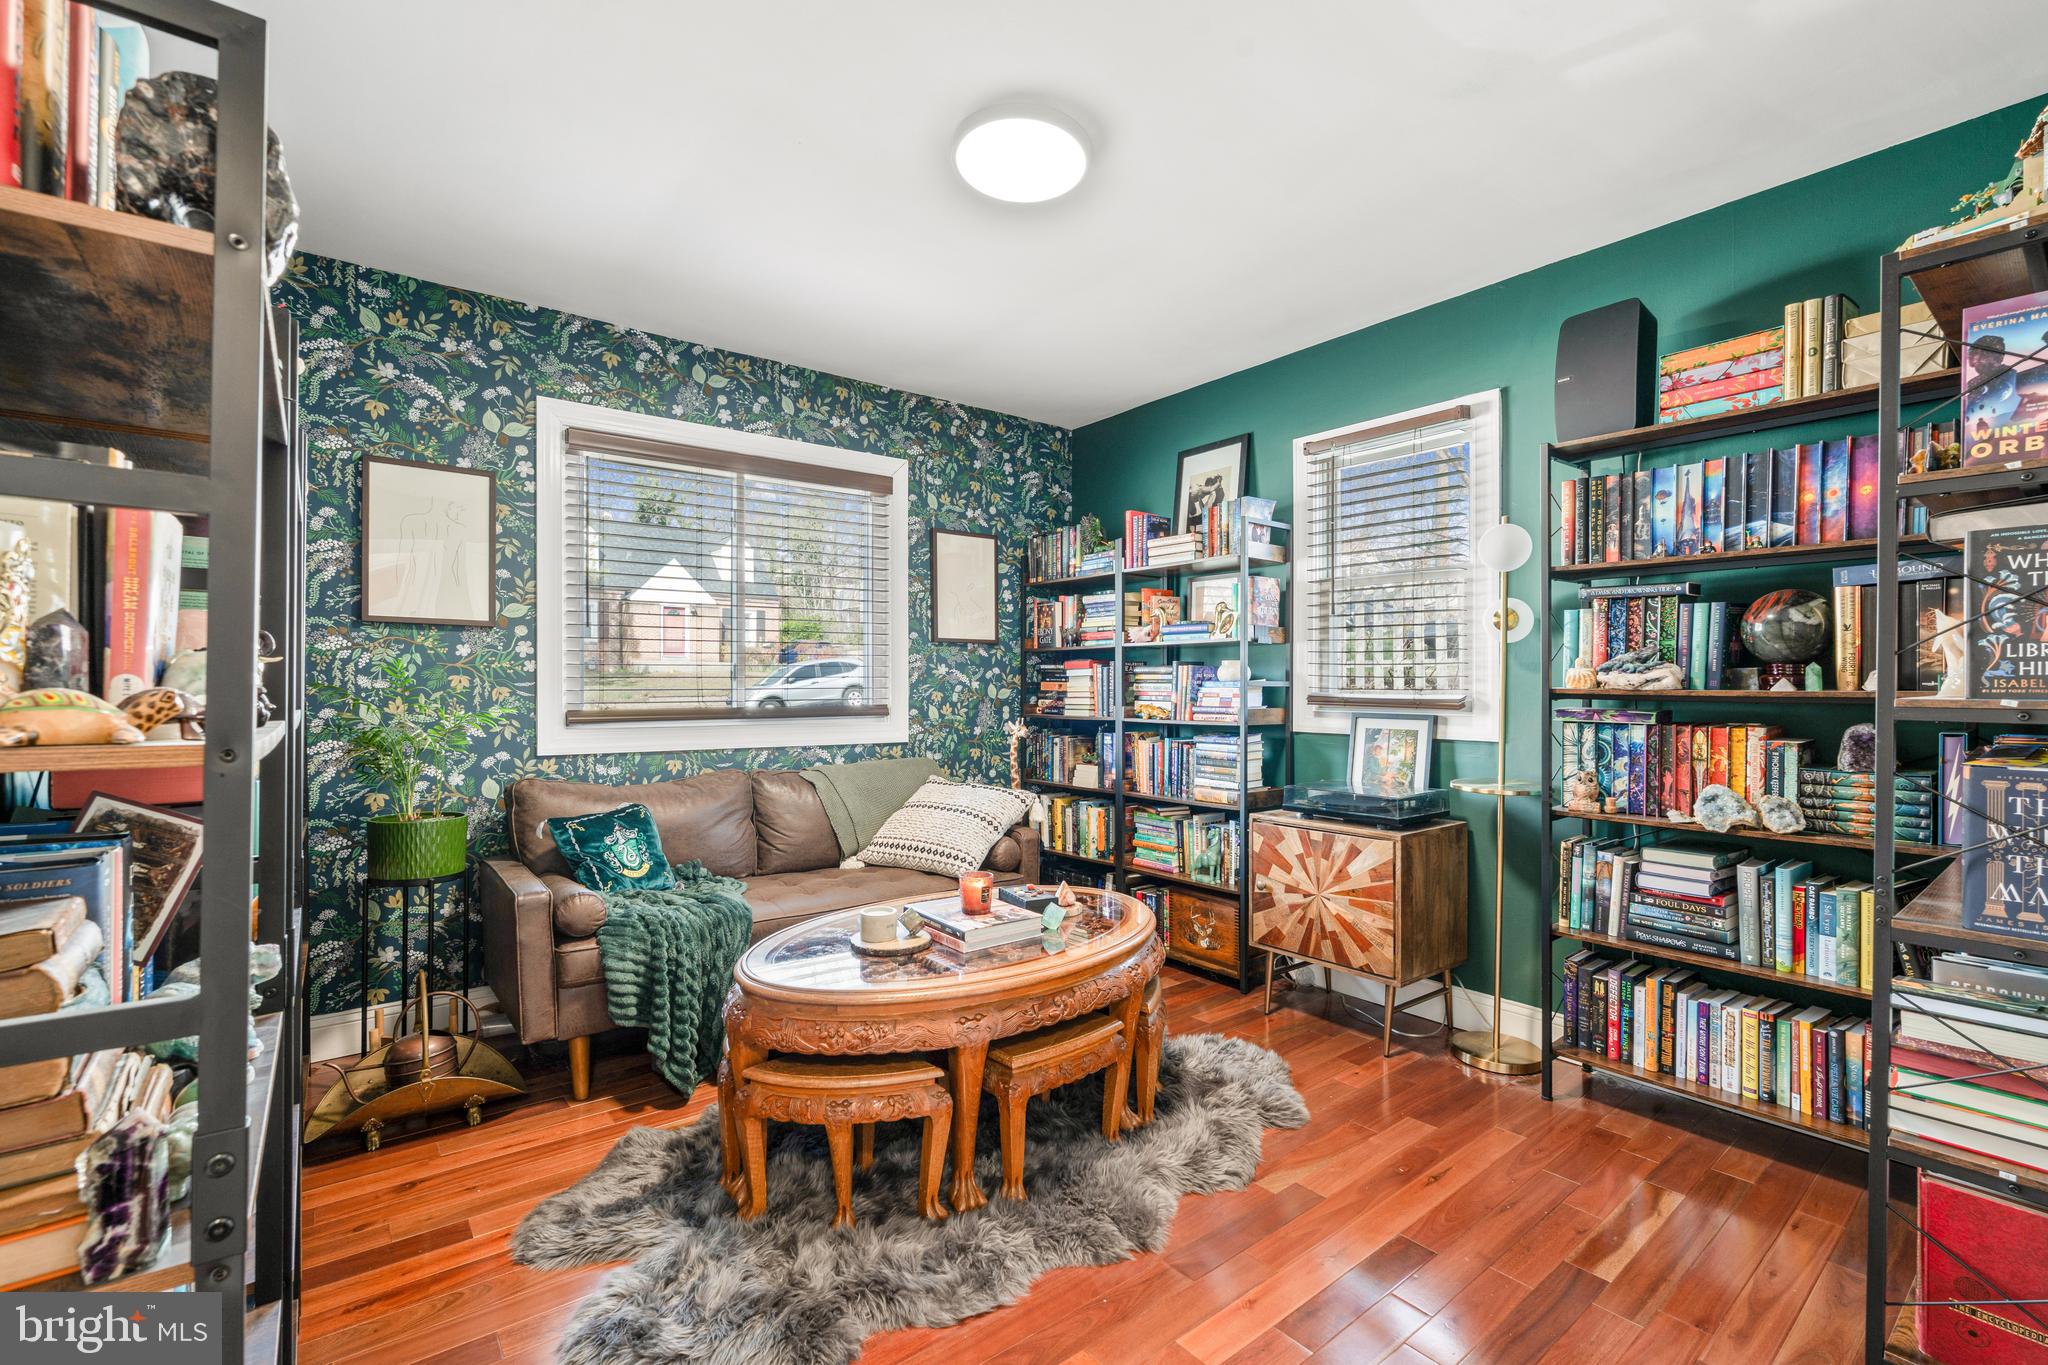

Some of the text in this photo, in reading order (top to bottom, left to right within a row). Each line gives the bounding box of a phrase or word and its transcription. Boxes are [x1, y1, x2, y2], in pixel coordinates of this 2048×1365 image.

[123, 576, 140, 610] DREAM
[1848, 653, 1856, 676] FOURTH
[1994, 679, 2046, 688] ISABEL
[5, 879, 72, 891] SOLDIERS
[1744, 872, 1752, 908] PROPHET
[1656, 899, 1707, 913] FOUL DAYS
[1976, 917, 2024, 927] JAMES
[1661, 1037, 1673, 1066] ERUPTION
[1832, 1099, 1840, 1116] CAST
